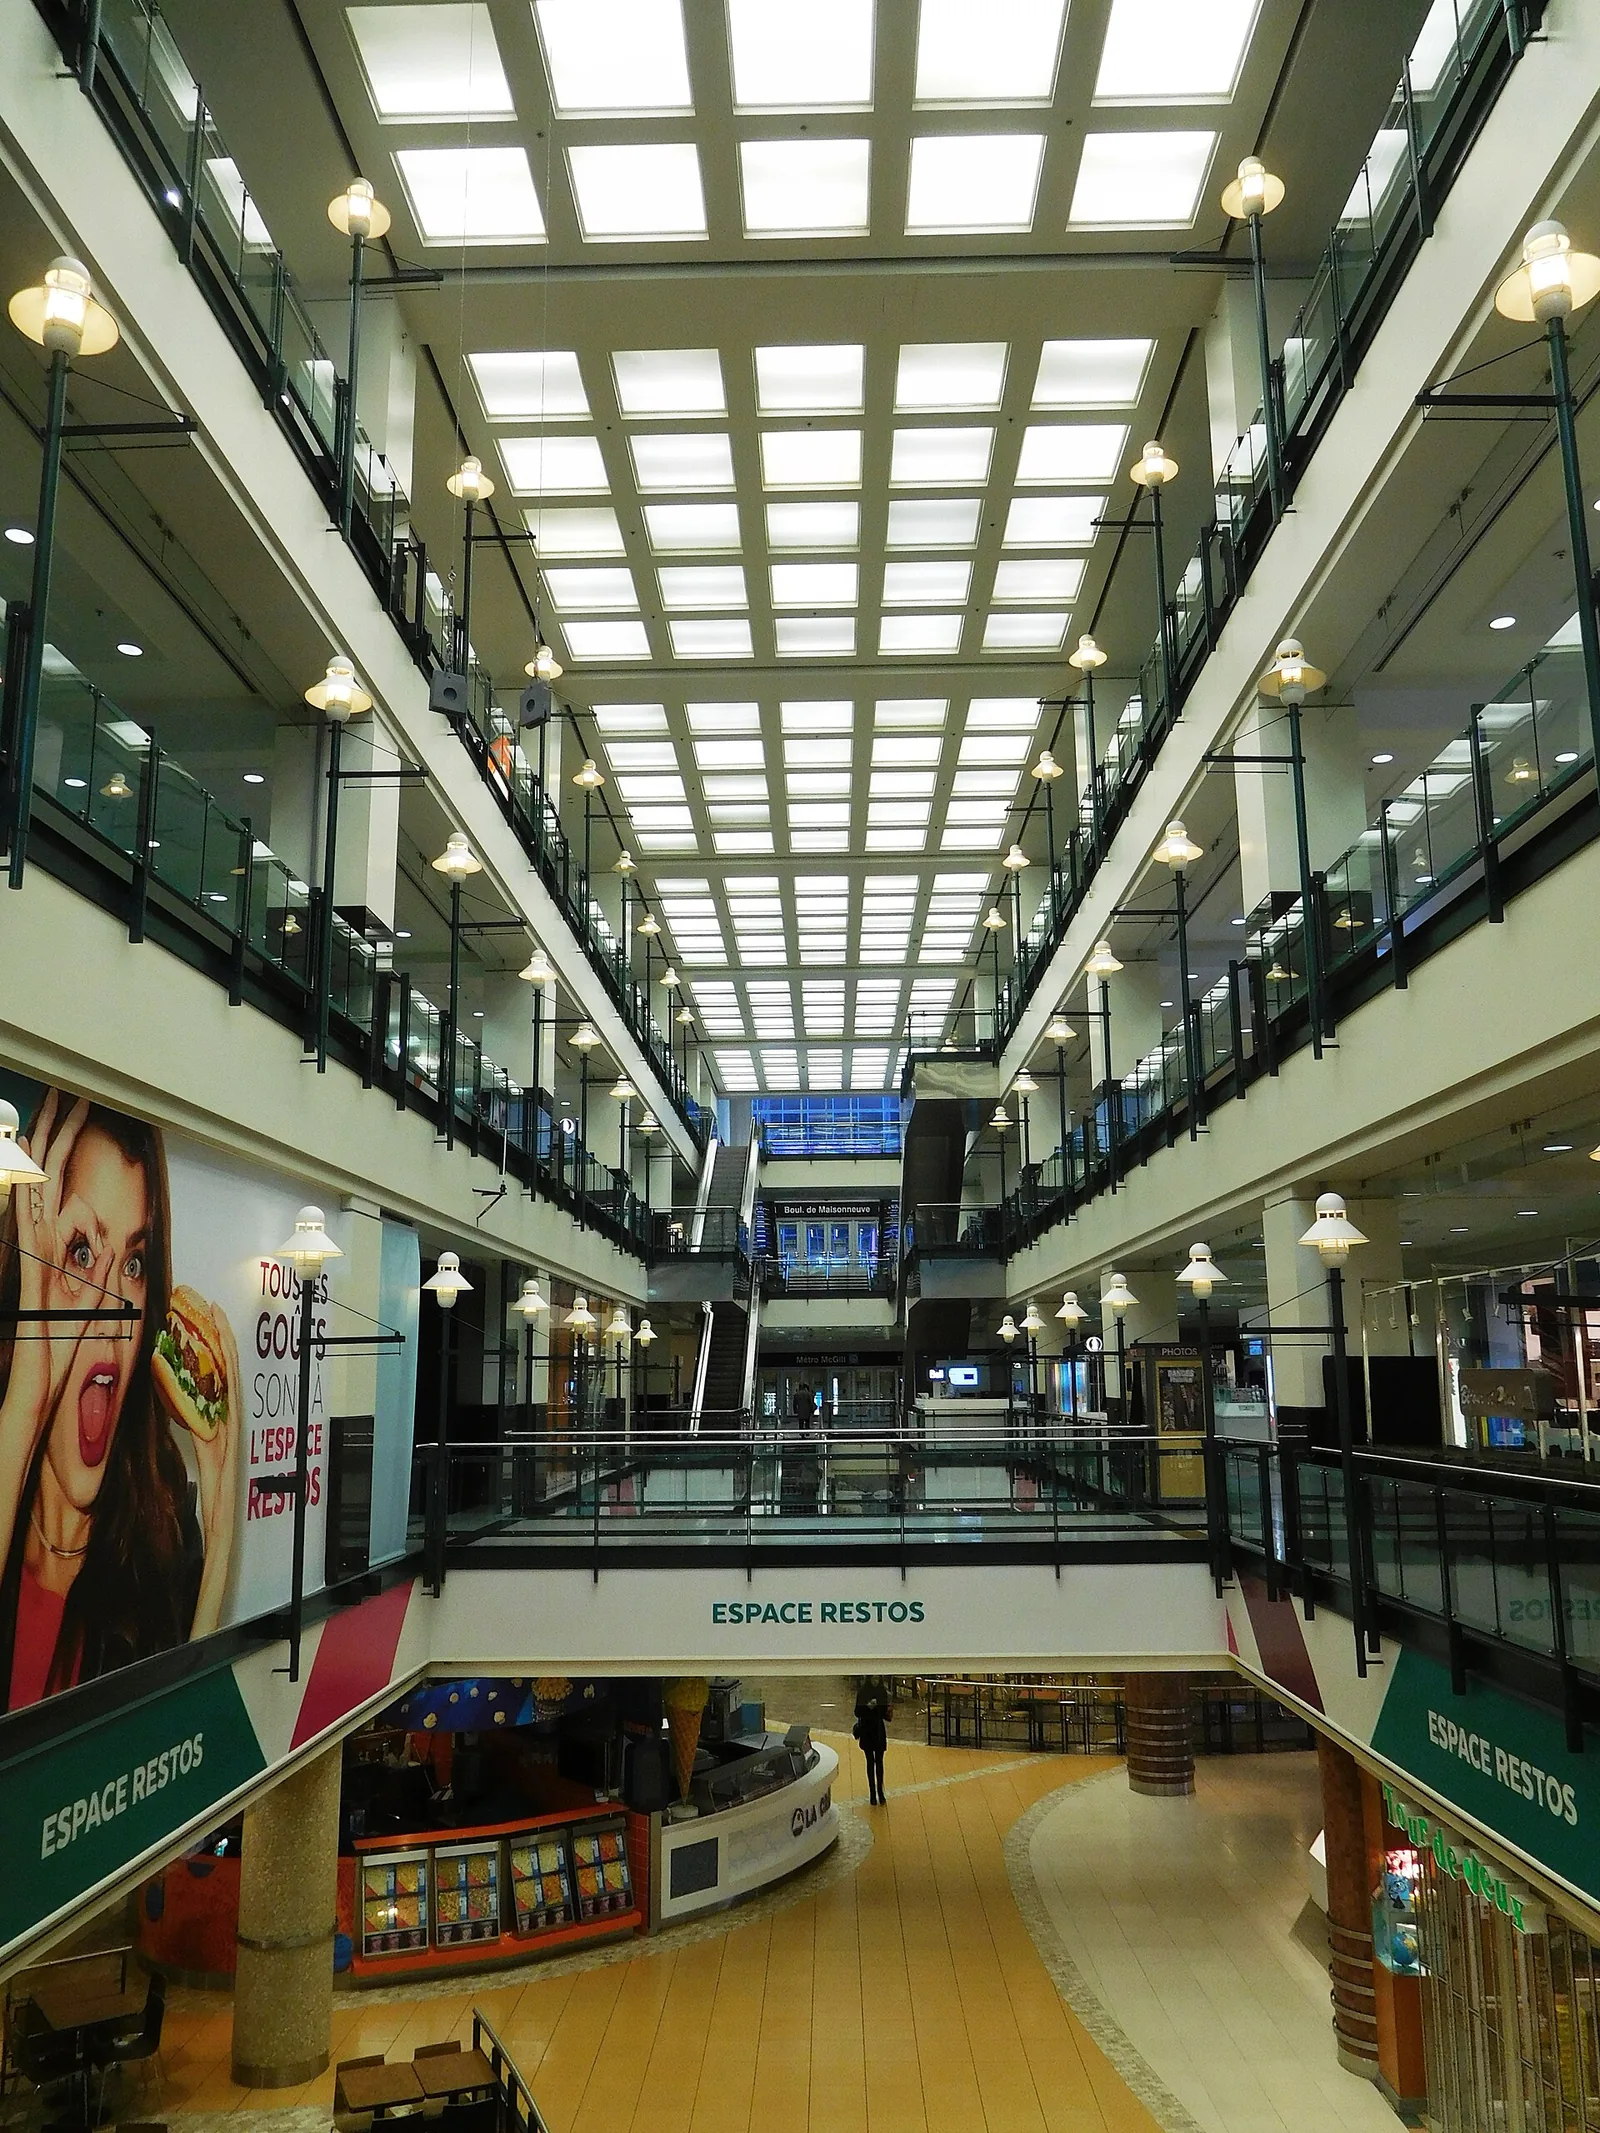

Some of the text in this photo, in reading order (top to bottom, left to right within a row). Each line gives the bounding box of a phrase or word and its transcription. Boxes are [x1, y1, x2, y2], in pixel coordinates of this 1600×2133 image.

[784, 1205, 871, 1214] Boul. de Maisonneuve
[260, 1261, 300, 1301] TOUS
[820, 1355, 846, 1364] McGill
[1161, 1347, 1198, 1356] PHOTOS
[252, 1362, 323, 1418] SON À
[250, 1424, 323, 1465] L'ESPCE
[712, 1601, 925, 1624] ESPACE RESTOS
[1428, 1709, 1578, 1826] ESPACE RESTOS
[41, 1732, 204, 1861] ESPACE RESTOS
[1382, 1780, 1428, 1848] Tour
[1432, 1827, 1459, 1881] de
